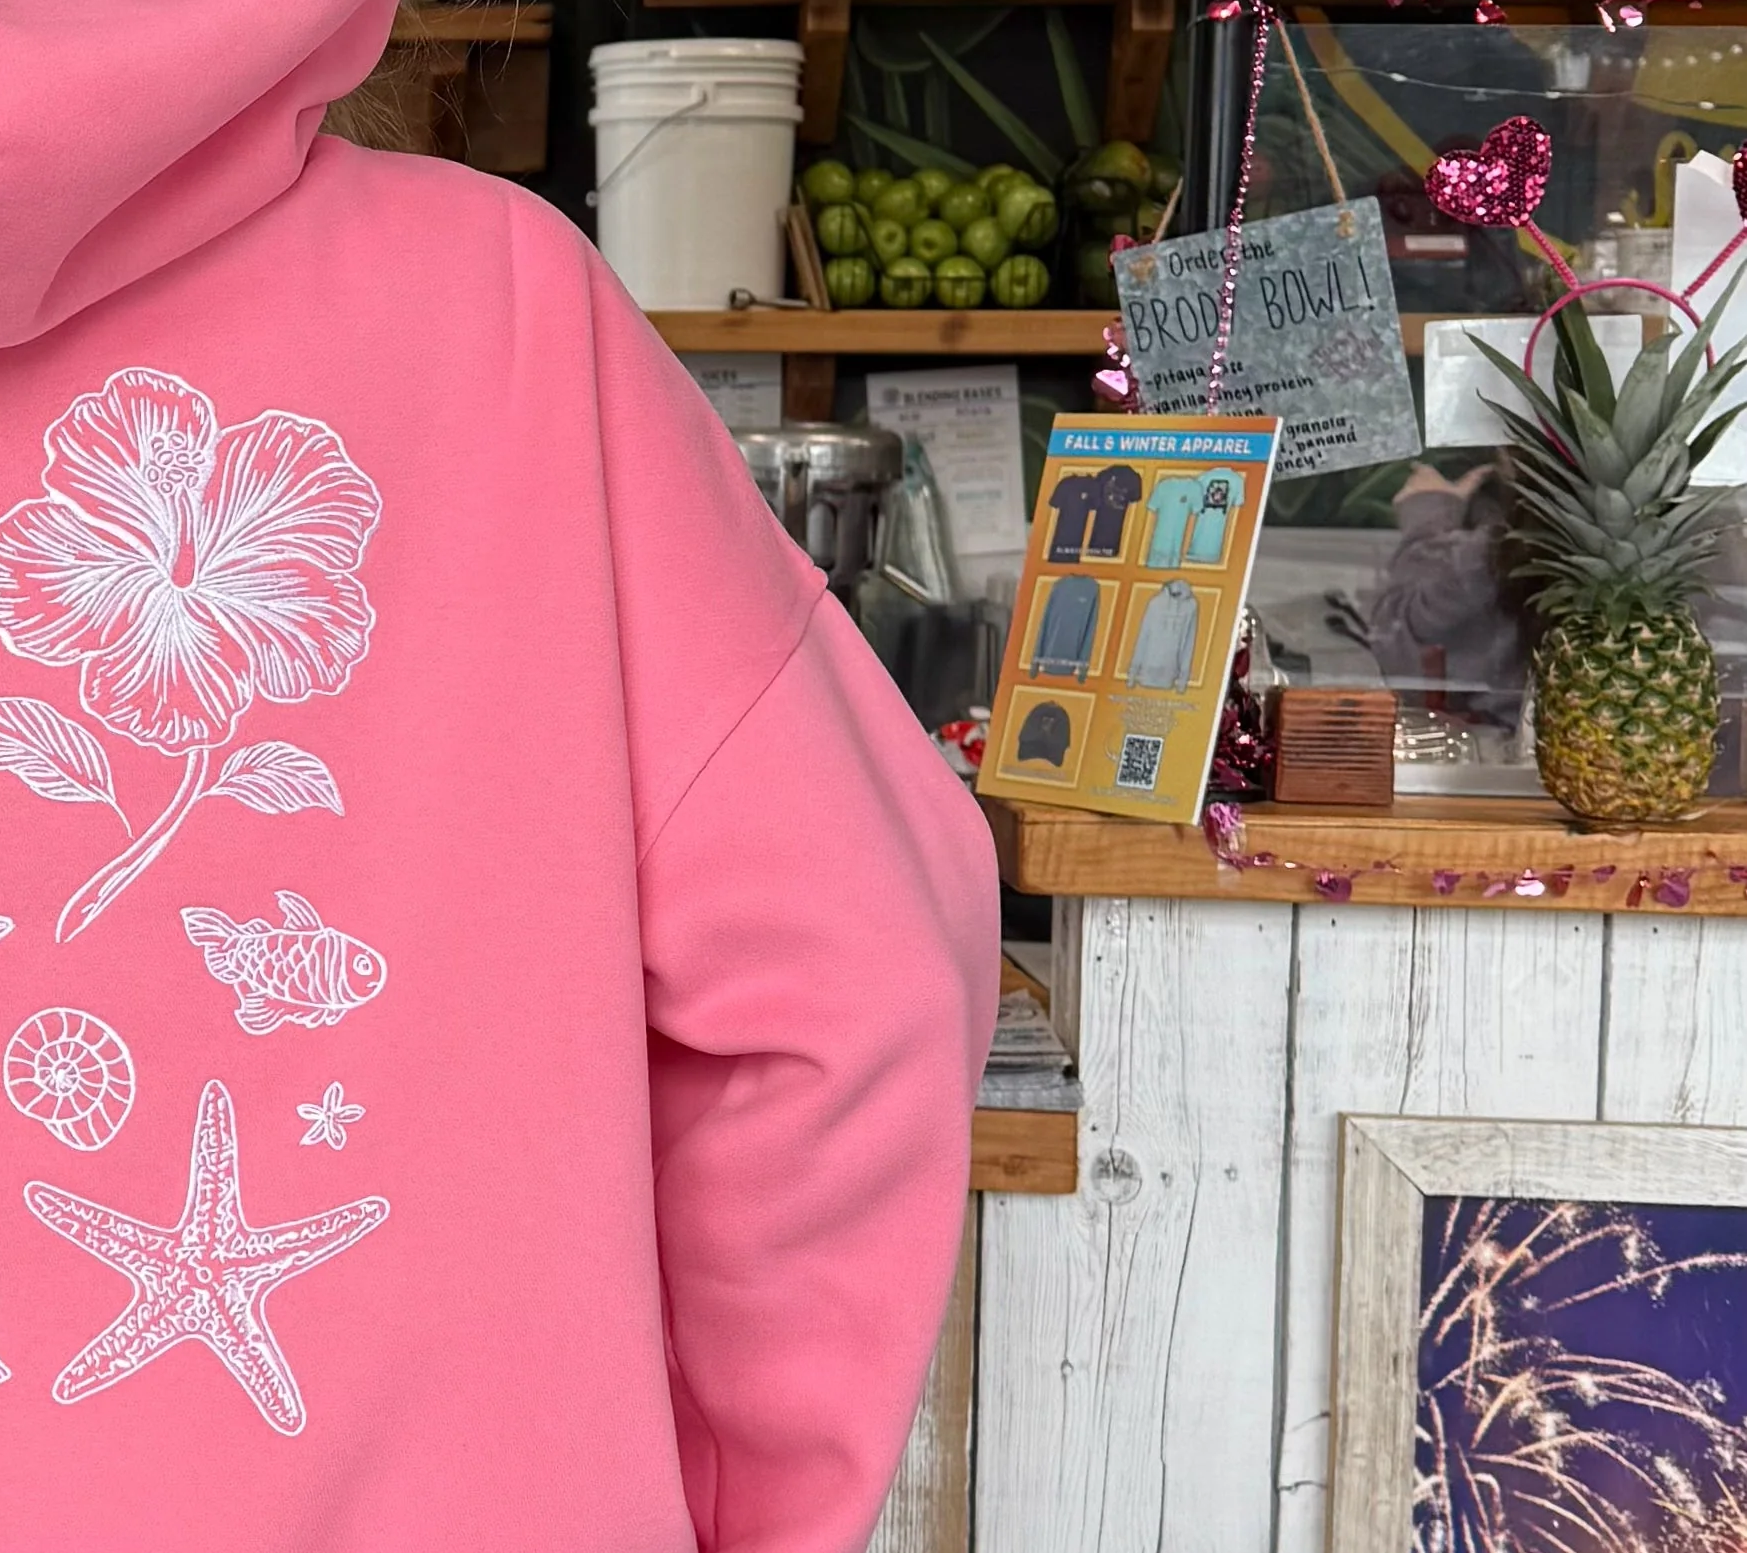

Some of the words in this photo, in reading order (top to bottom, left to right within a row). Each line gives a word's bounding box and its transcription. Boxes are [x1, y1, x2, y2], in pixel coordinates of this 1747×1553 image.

[1241, 239, 1275, 262] the
[1260, 255, 1376, 331] BOWL!
[1256, 375, 1314, 397] protein
[1064, 434, 1101, 450] FALL
[1120, 435, 1176, 452] WINTER
[1181, 437, 1252, 454] APPAREL
